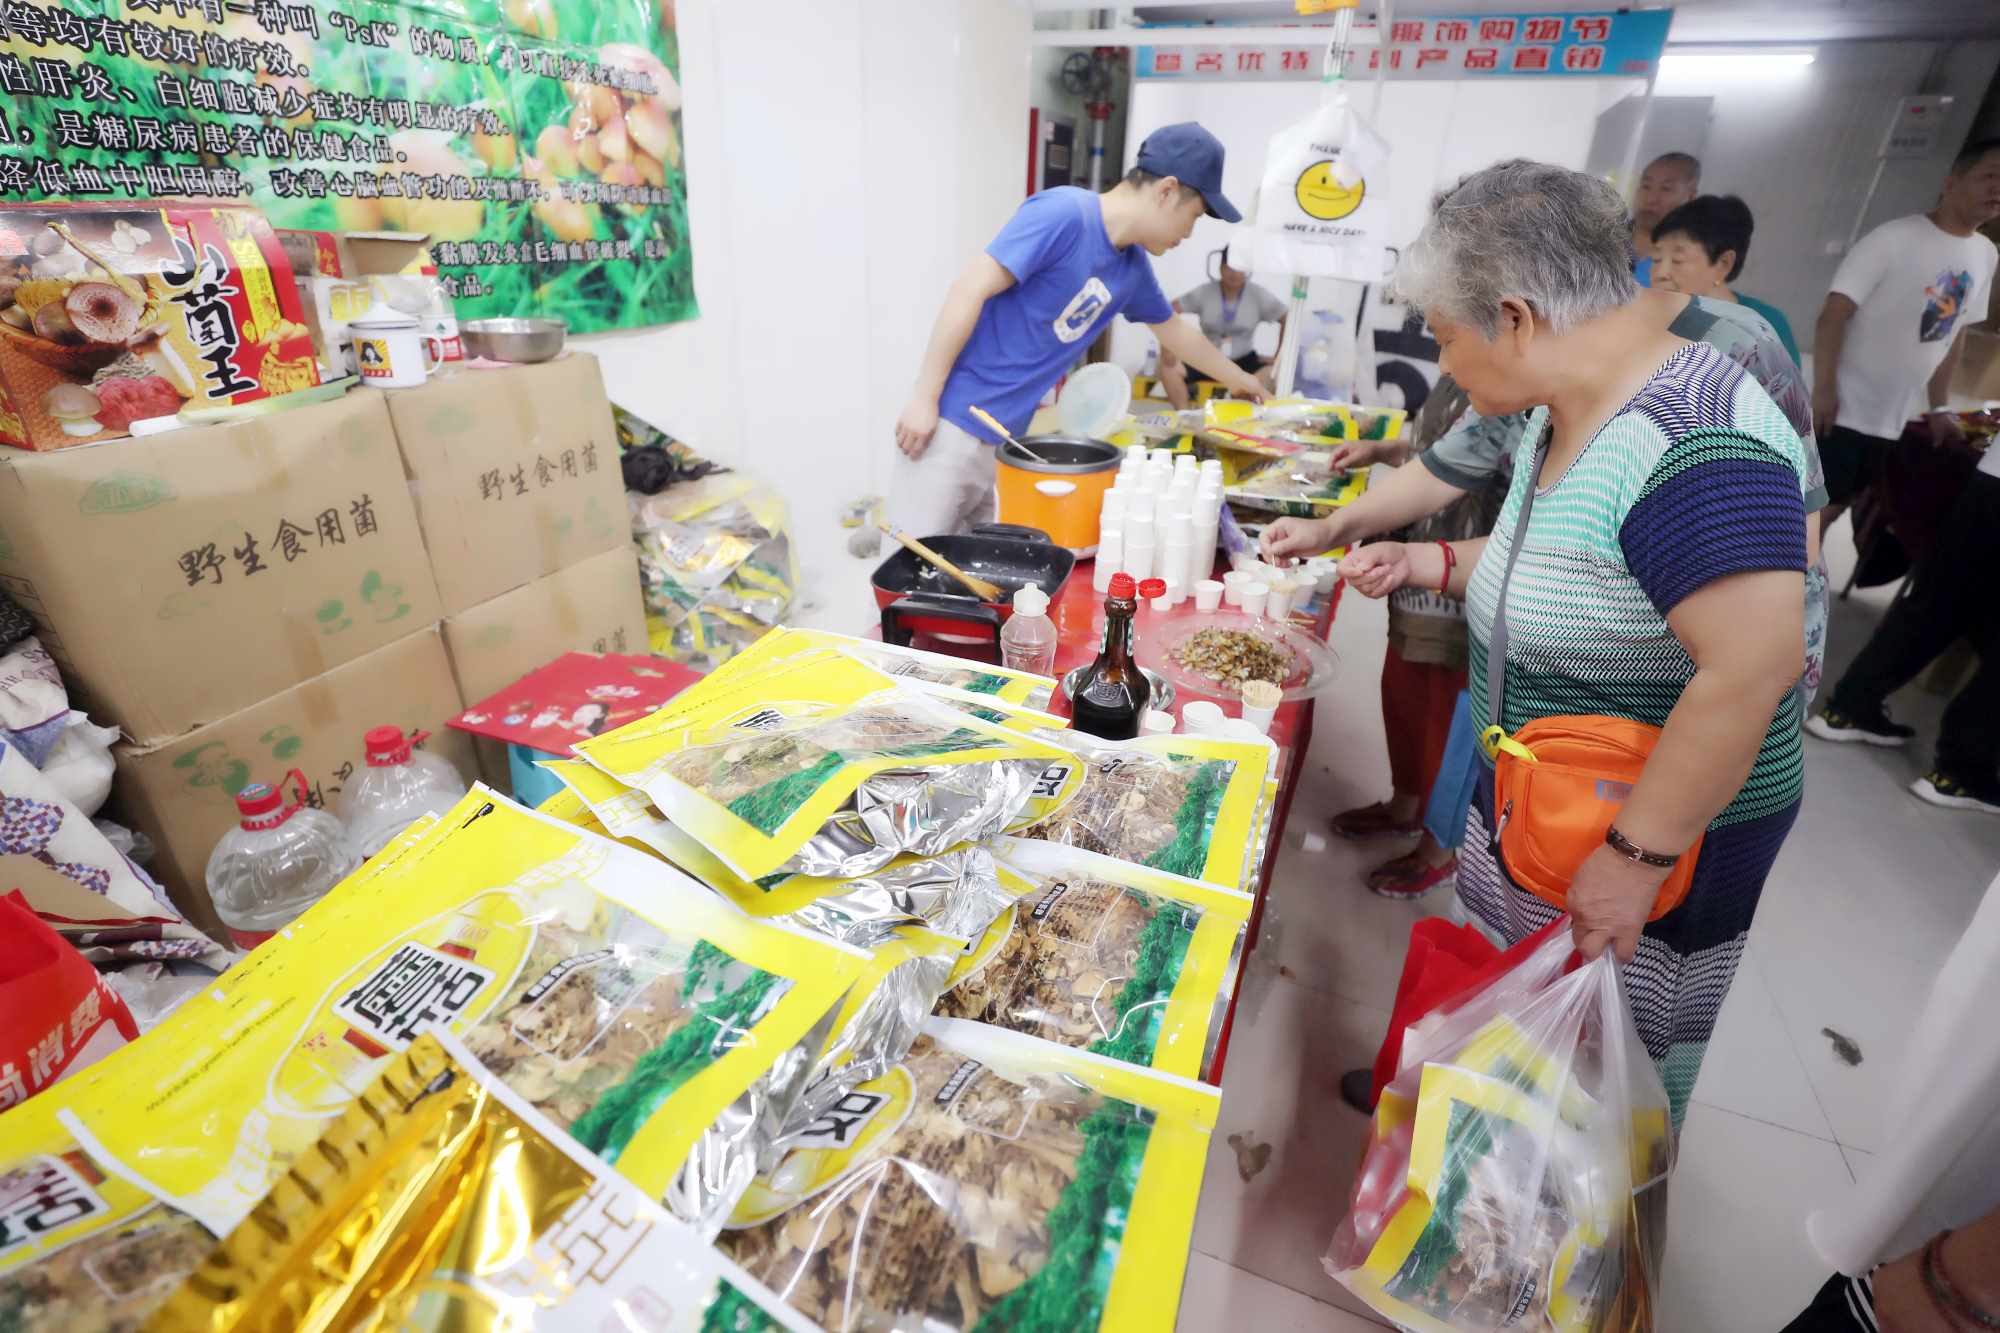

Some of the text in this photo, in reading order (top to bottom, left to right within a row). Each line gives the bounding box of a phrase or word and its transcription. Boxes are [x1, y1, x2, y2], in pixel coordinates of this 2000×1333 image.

[177, 494, 378, 586] 野生食用菌
